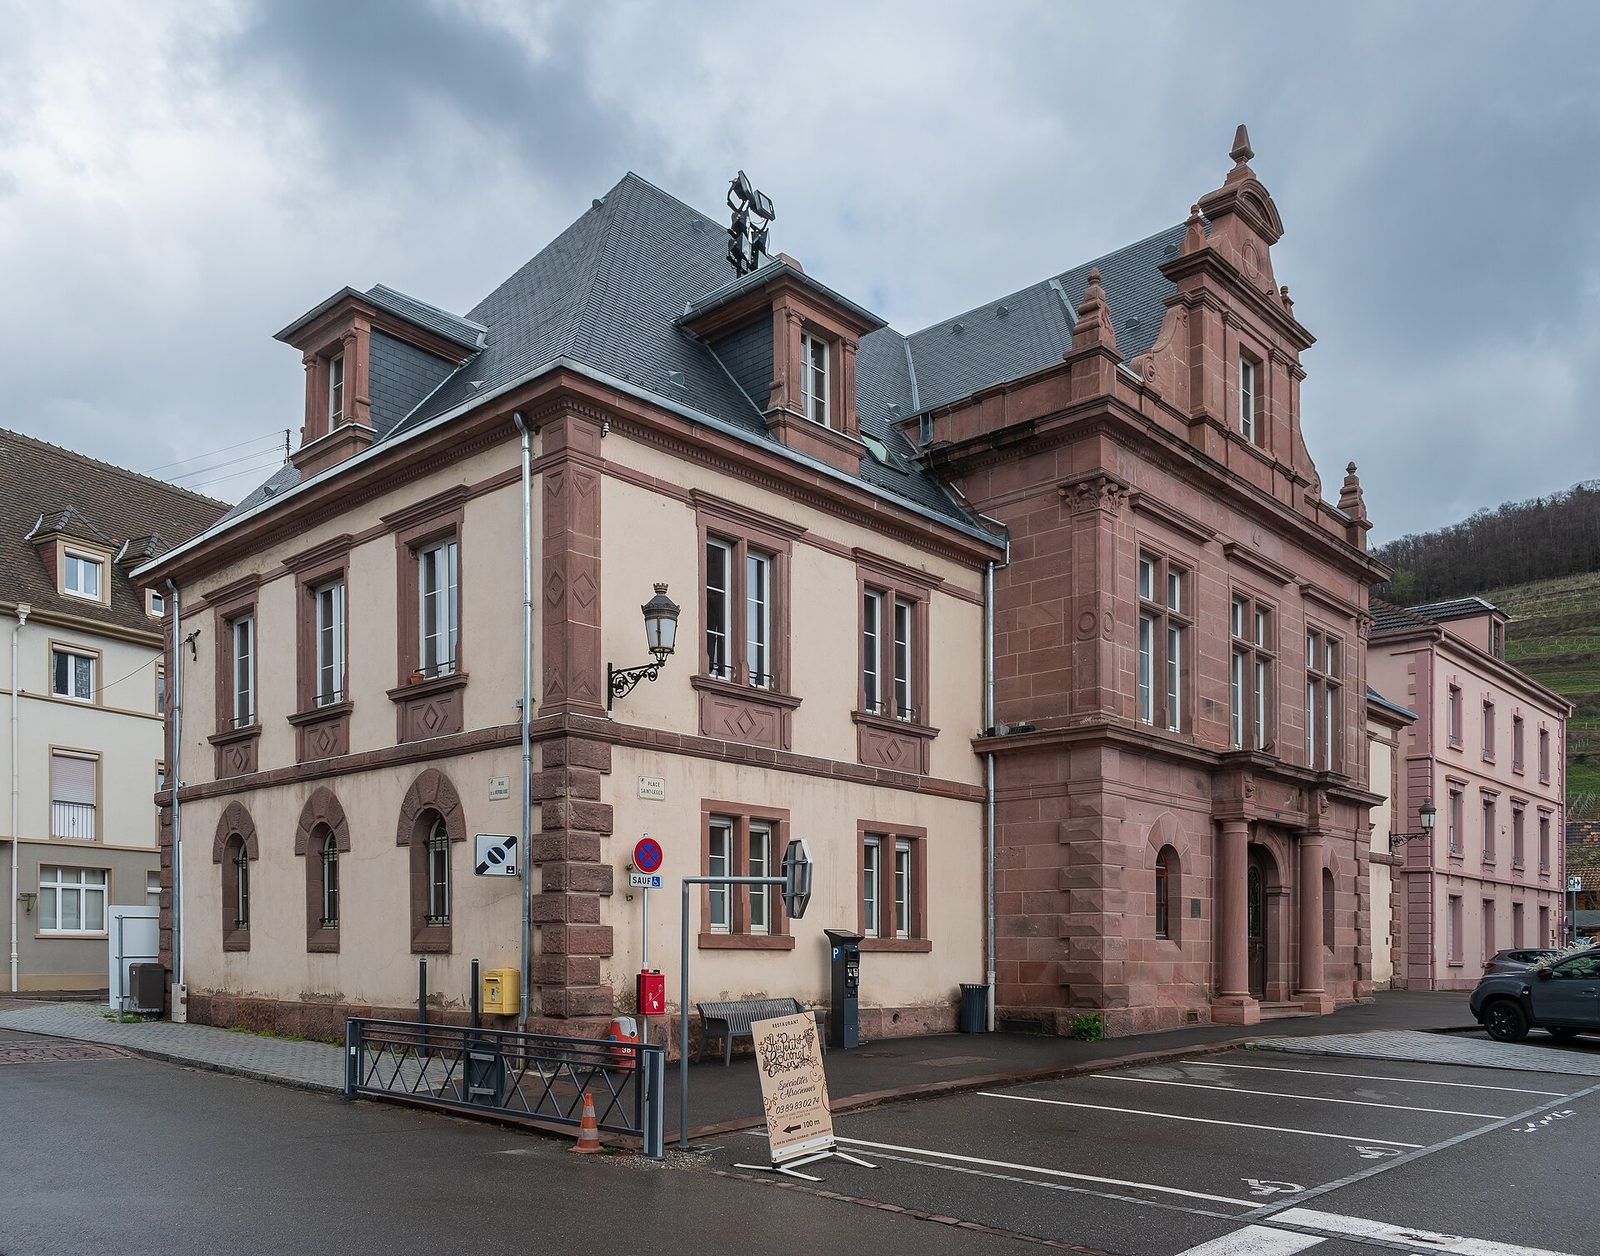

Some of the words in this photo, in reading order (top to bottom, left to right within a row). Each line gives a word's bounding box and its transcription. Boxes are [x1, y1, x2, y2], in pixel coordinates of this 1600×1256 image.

[632, 876, 651, 885] SAUF
[833, 947, 839, 959] P
[772, 1019, 799, 1028] RESTAURANT
[803, 1119, 814, 1128] 100
